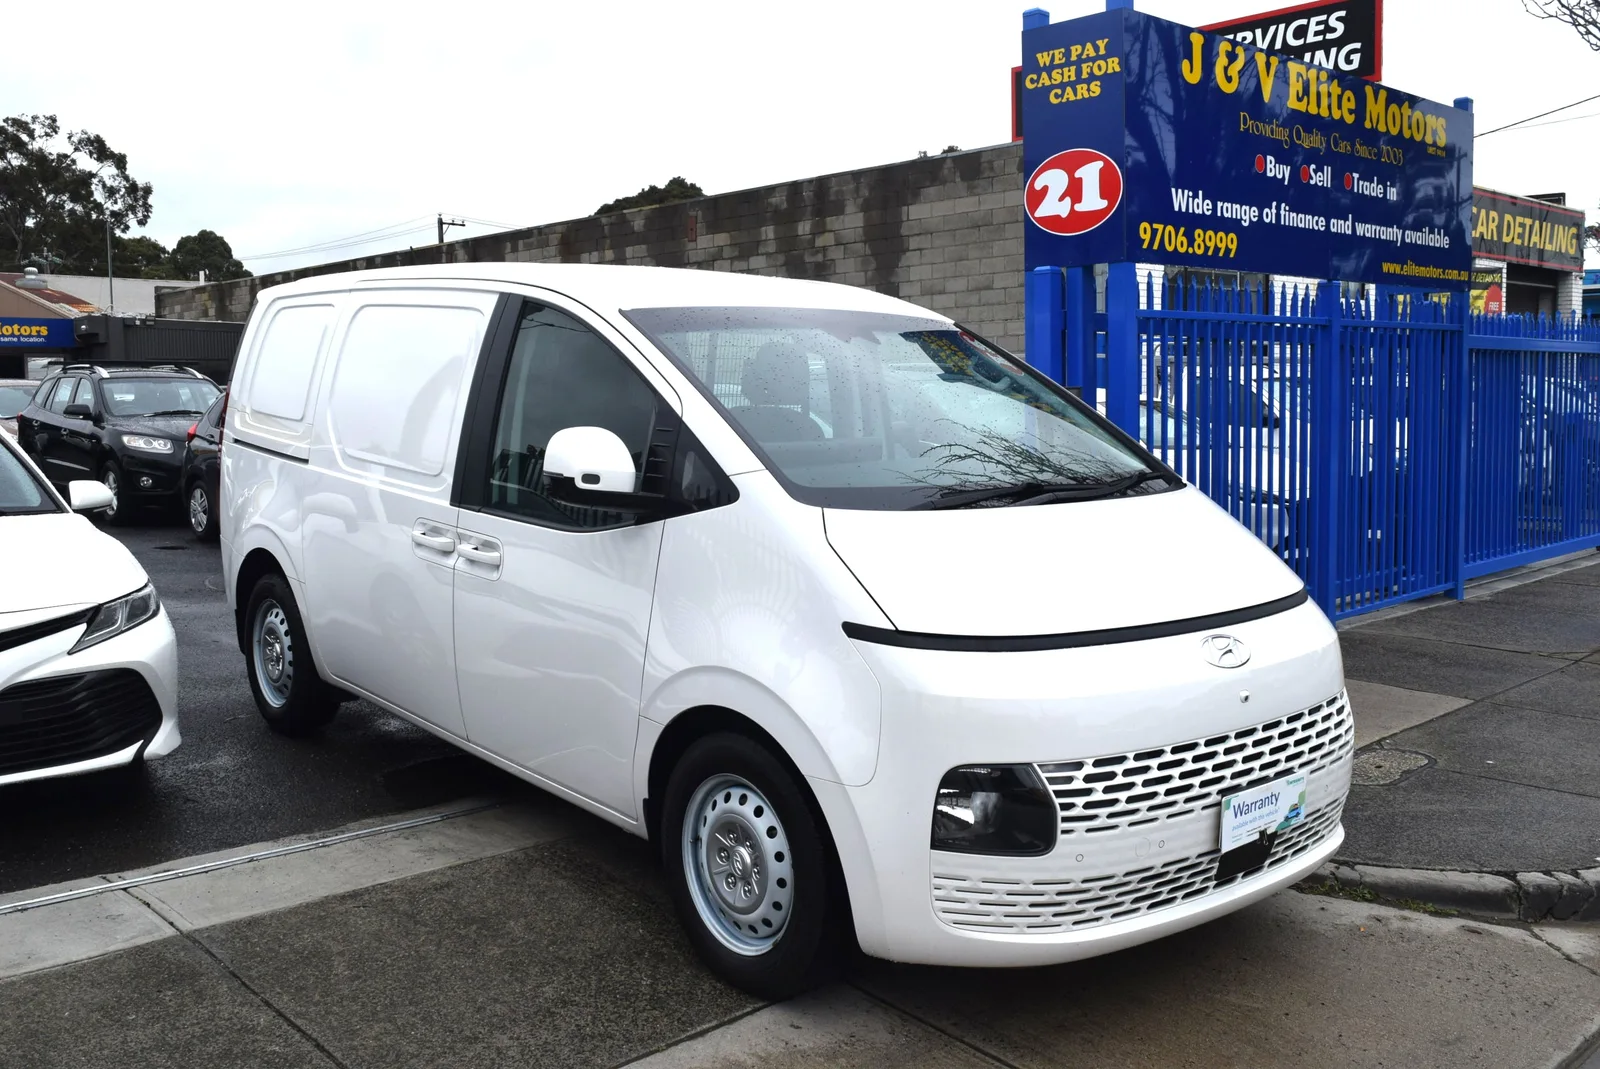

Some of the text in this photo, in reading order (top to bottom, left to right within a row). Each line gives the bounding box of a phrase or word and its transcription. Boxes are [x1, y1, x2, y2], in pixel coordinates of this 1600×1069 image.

[1036, 38, 1109, 67] WE PAY
[1025, 57, 1121, 89] CASH FOR
[1049, 80, 1101, 104] CARS
[1181, 32, 1447, 148] J & V Elite Motors
[1239, 111, 1291, 149] Providing
[1293, 124, 1327, 155] Quality
[1330, 133, 1351, 154] Cars
[1354, 138, 1378, 160] Since
[1380, 145, 1404, 166] 2003
[1266, 155, 1291, 186] Buy
[1309, 164, 1332, 188] Sell
[1034, 160, 1108, 218] 21
[1352, 172, 1397, 201] Trade in
[1170, 187, 1450, 249] Wide range of finance and warranty available
[1139, 221, 1238, 258] 9706.8999
[1502, 213, 1578, 255] DETAILING
[1382, 259, 1469, 282] www.elitemotors.com.au
[1232, 791, 1281, 820] Warranty
